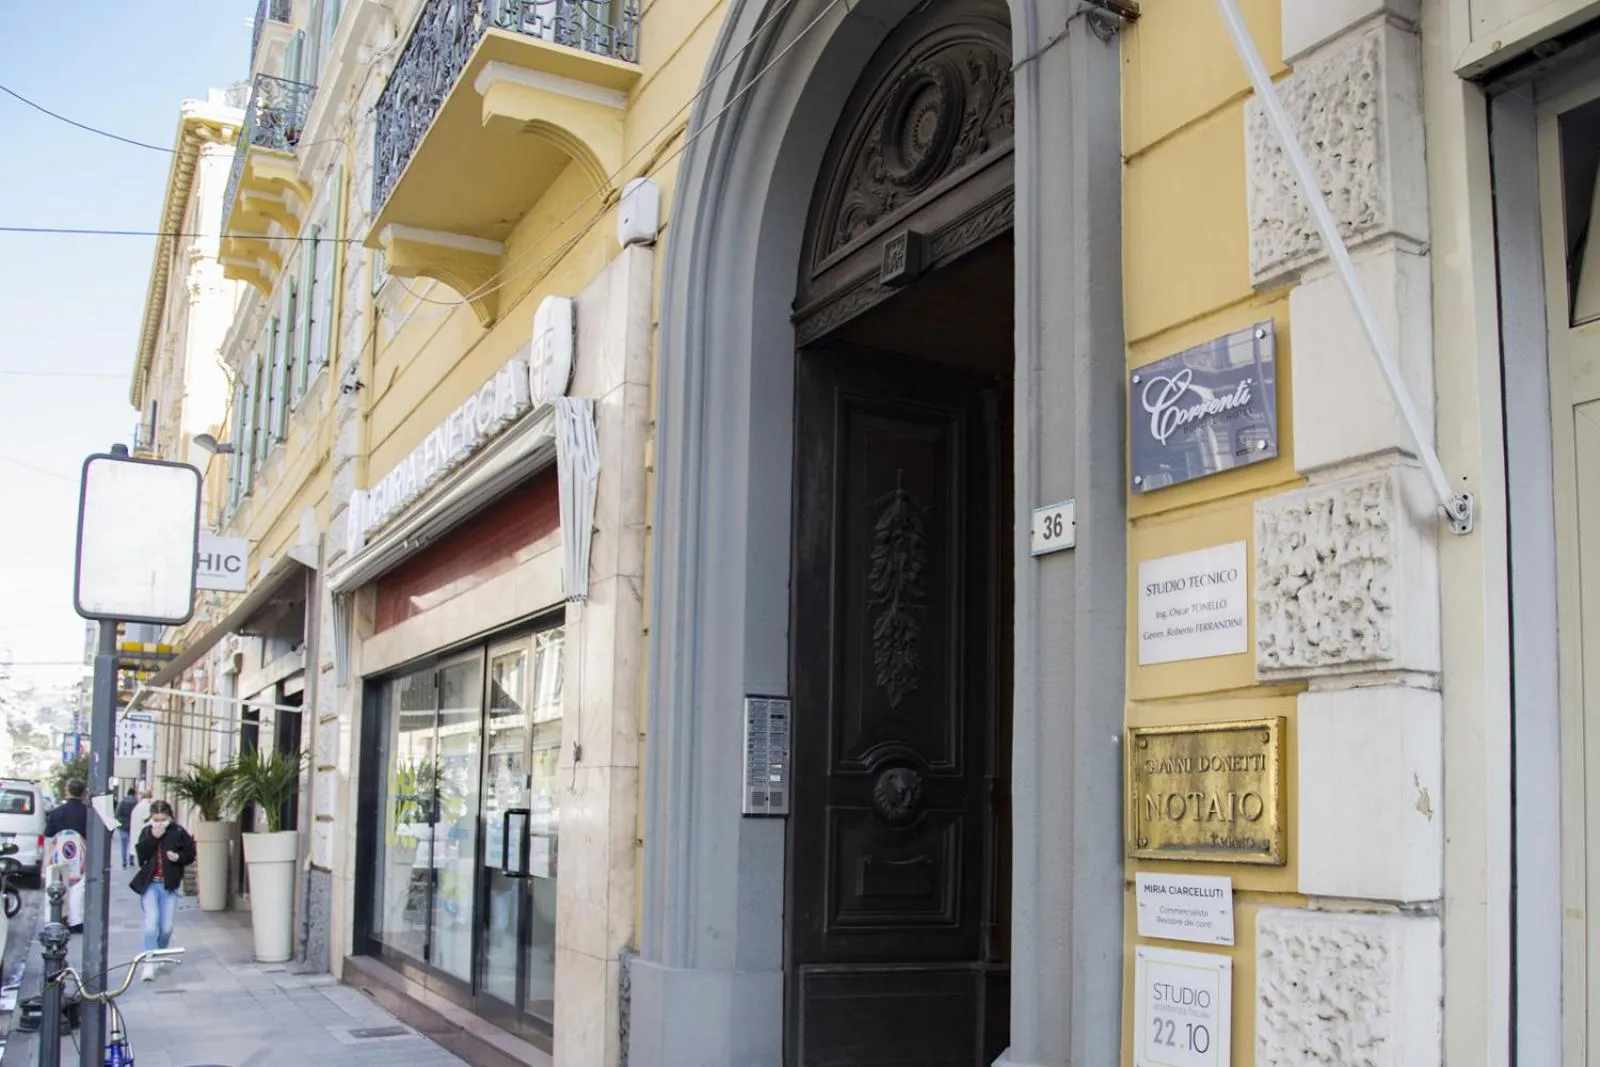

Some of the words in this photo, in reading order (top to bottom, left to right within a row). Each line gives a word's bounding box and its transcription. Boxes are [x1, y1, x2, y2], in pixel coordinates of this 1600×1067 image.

[423, 360, 519, 479] ENERGIA
[1142, 368, 1252, 446] Correnti
[1043, 513, 1063, 540] 36
[1145, 578, 1186, 598] STUDIO
[1188, 568, 1238, 588] TECNICO
[1191, 599, 1228, 613] TONELLO
[1166, 625, 1194, 637] Roberto
[1195, 617, 1243, 633] FERRANDINI
[1143, 756, 1193, 774] GIANNI
[1198, 754, 1266, 773] DONETTI
[1144, 791, 1264, 823] NOTAIO
[1143, 883, 1167, 896] MIRIA
[1168, 885, 1224, 899] CIARCELLUTI
[1159, 905, 1209, 918] Commercialista
[1153, 981, 1211, 1009] STUDIO
